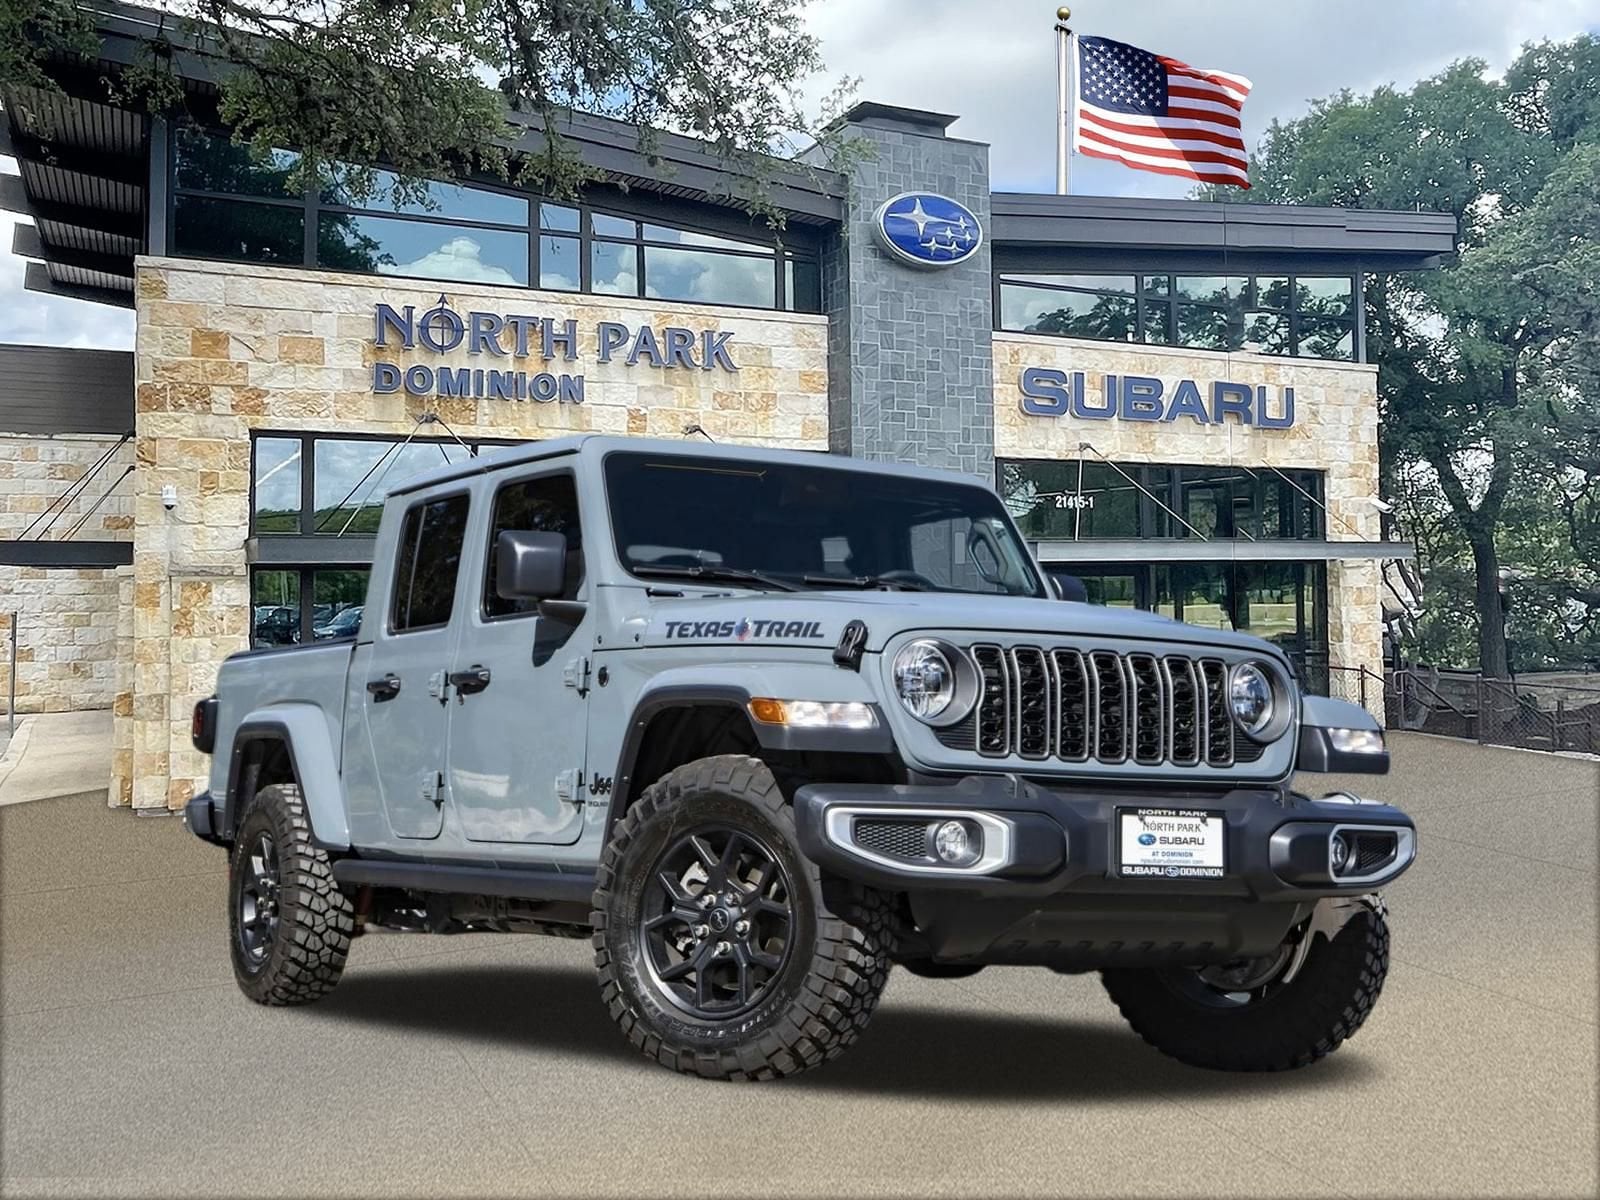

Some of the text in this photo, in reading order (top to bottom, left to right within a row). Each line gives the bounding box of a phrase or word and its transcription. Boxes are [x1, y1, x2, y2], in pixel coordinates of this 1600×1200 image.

[374, 293, 741, 373] NORTH PARK
[373, 362, 585, 404] DOMINION
[1018, 367, 1295, 430] SUBARU
[665, 619, 825, 639] TEXAS TRAIL
[589, 772, 612, 795] Jee
[1138, 808, 1176, 816] NORTH
[1142, 820, 1202, 833] NORTH PARK
[1159, 836, 1205, 846] SUBARU
[1122, 866, 1223, 877] SUBARU DOMINION
